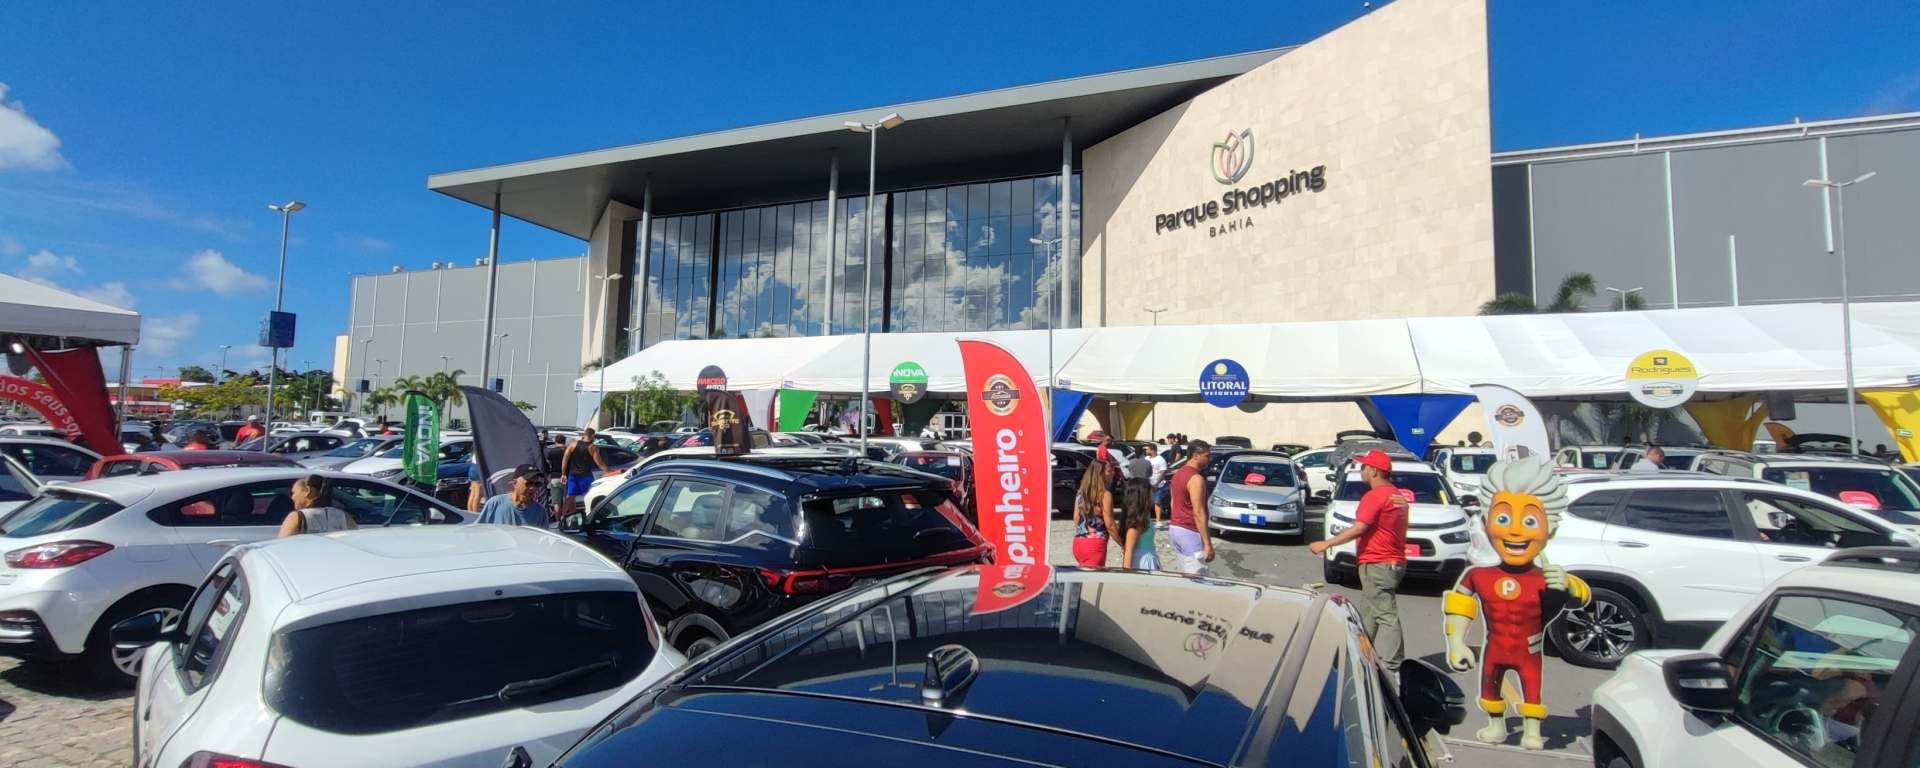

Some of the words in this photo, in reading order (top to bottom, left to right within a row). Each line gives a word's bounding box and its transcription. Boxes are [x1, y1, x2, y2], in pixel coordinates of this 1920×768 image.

[1155, 199, 1219, 235] Parque
[1222, 164, 1327, 215] Shopping
[1209, 216, 1254, 238] BAHIA
[1201, 381, 1247, 390] LITORAL
[31, 390, 68, 416] seus
[995, 428, 1035, 566] pinheiro
[1502, 579, 1517, 596] P
